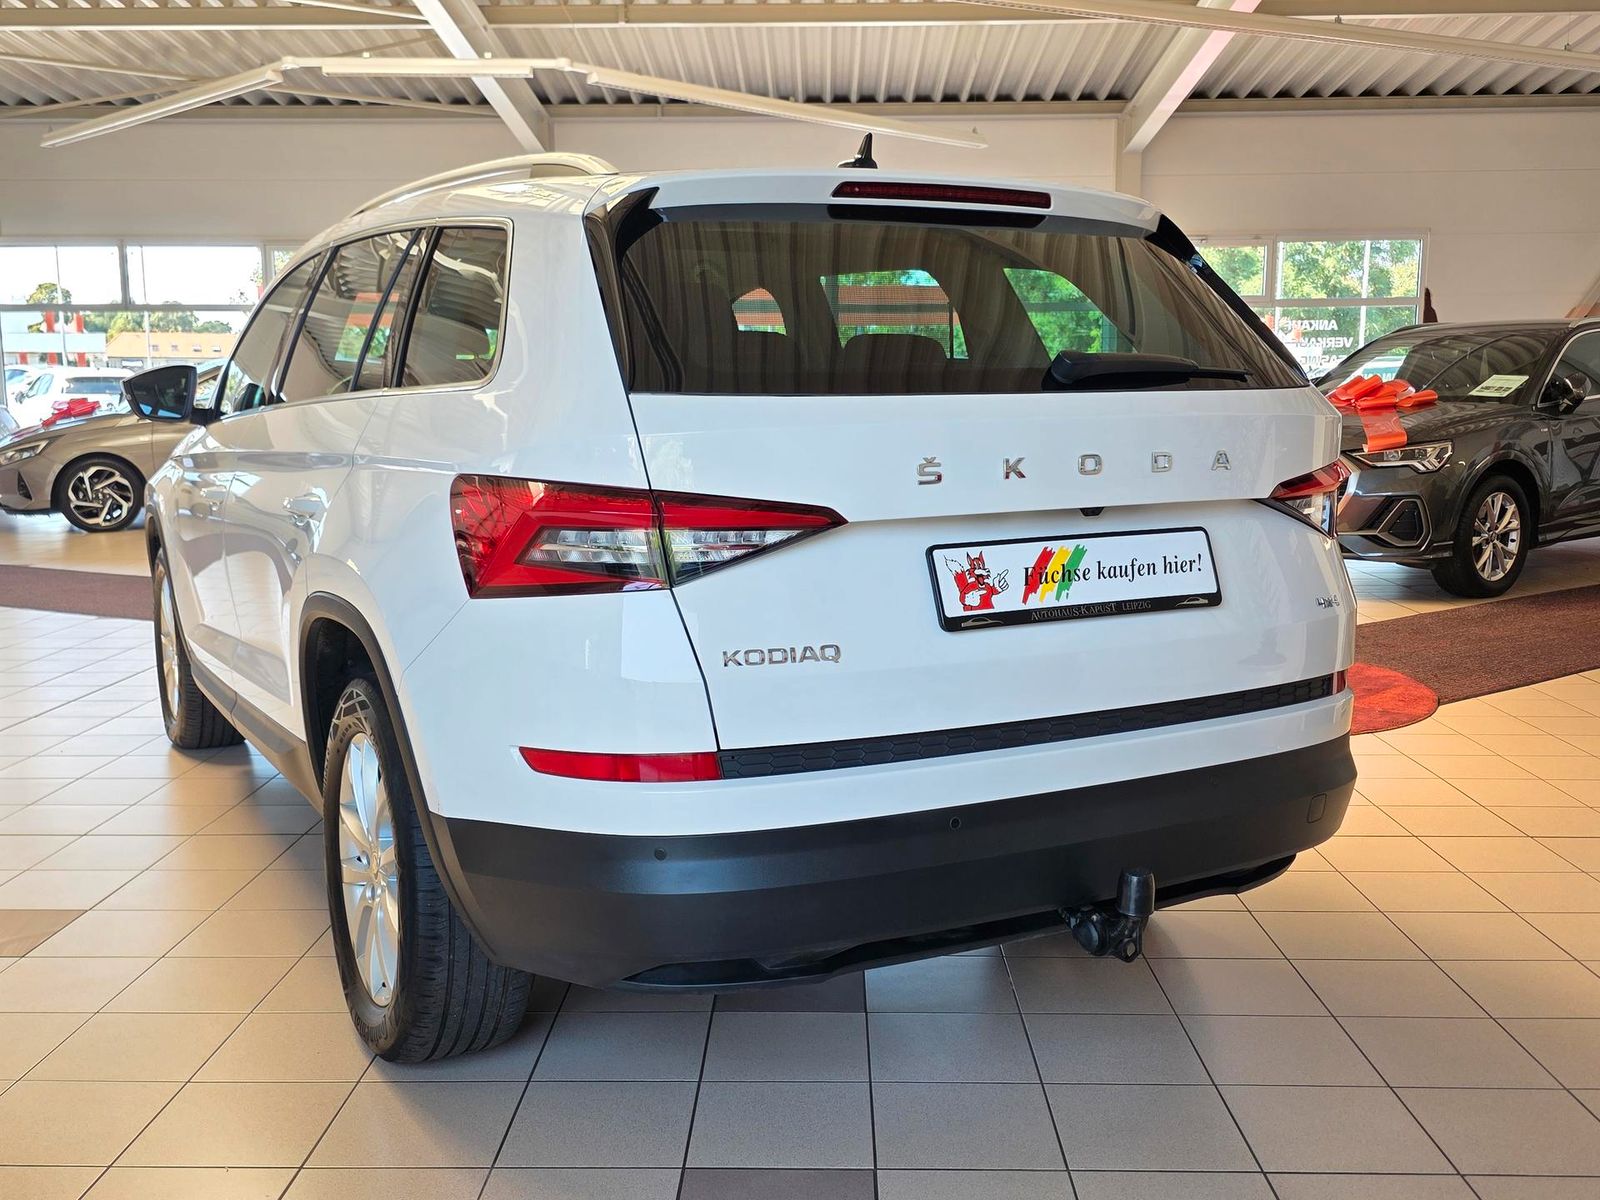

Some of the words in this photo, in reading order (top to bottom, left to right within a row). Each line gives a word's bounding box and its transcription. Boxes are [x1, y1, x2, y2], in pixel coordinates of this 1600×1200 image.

[1023, 563, 1091, 587] Füchse
[1096, 557, 1157, 583] kaufen
[1162, 553, 1202, 574] hier!
[1121, 600, 1152, 612] LEIPZIG
[722, 644, 842, 668] KODIAQ
